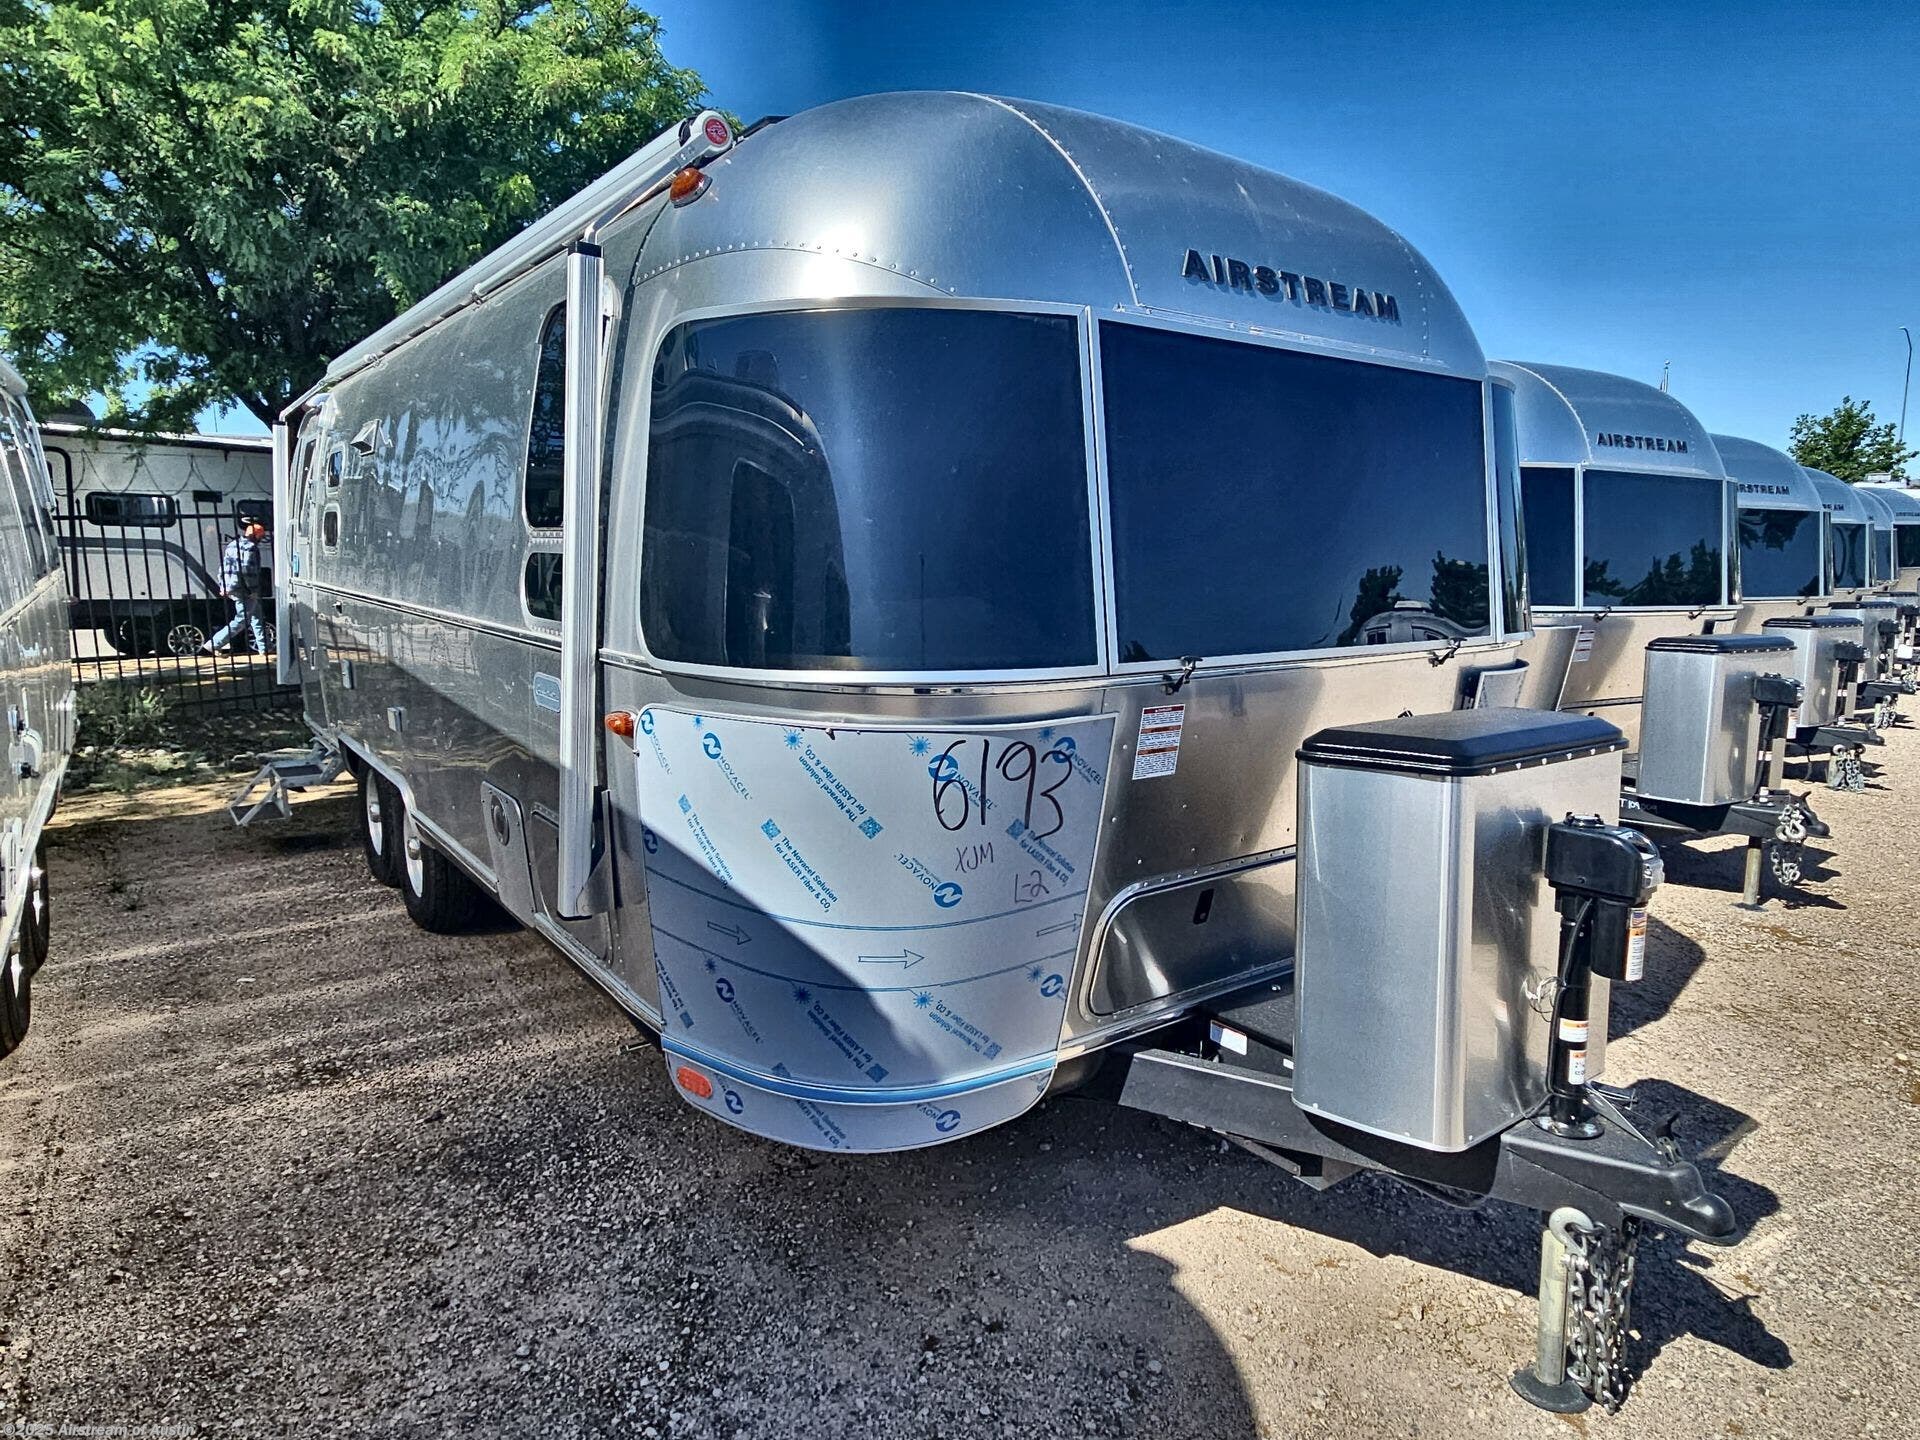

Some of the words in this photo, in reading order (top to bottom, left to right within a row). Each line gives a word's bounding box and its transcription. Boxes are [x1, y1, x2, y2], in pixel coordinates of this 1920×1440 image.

[1181, 248, 1400, 322] AIRSTREAM
[1597, 432, 1688, 454] AIRSTREAM
[1736, 483, 1790, 496] RSTREAM
[719, 755, 751, 800] NOVACEL
[799, 756, 823, 784] Solution
[1073, 754, 1102, 785] NOVACEL
[820, 784, 846, 810] Novacel
[835, 782, 857, 805] LASER
[932, 738, 1073, 841] 6193
[782, 837, 792, 850] The
[792, 850, 816, 876] Novacel
[813, 875, 838, 902] Solution
[782, 853, 802, 876] LASER
[800, 876, 816, 892] Fiber
[897, 853, 938, 890] NOVACEL
[955, 841, 994, 873] XJM
